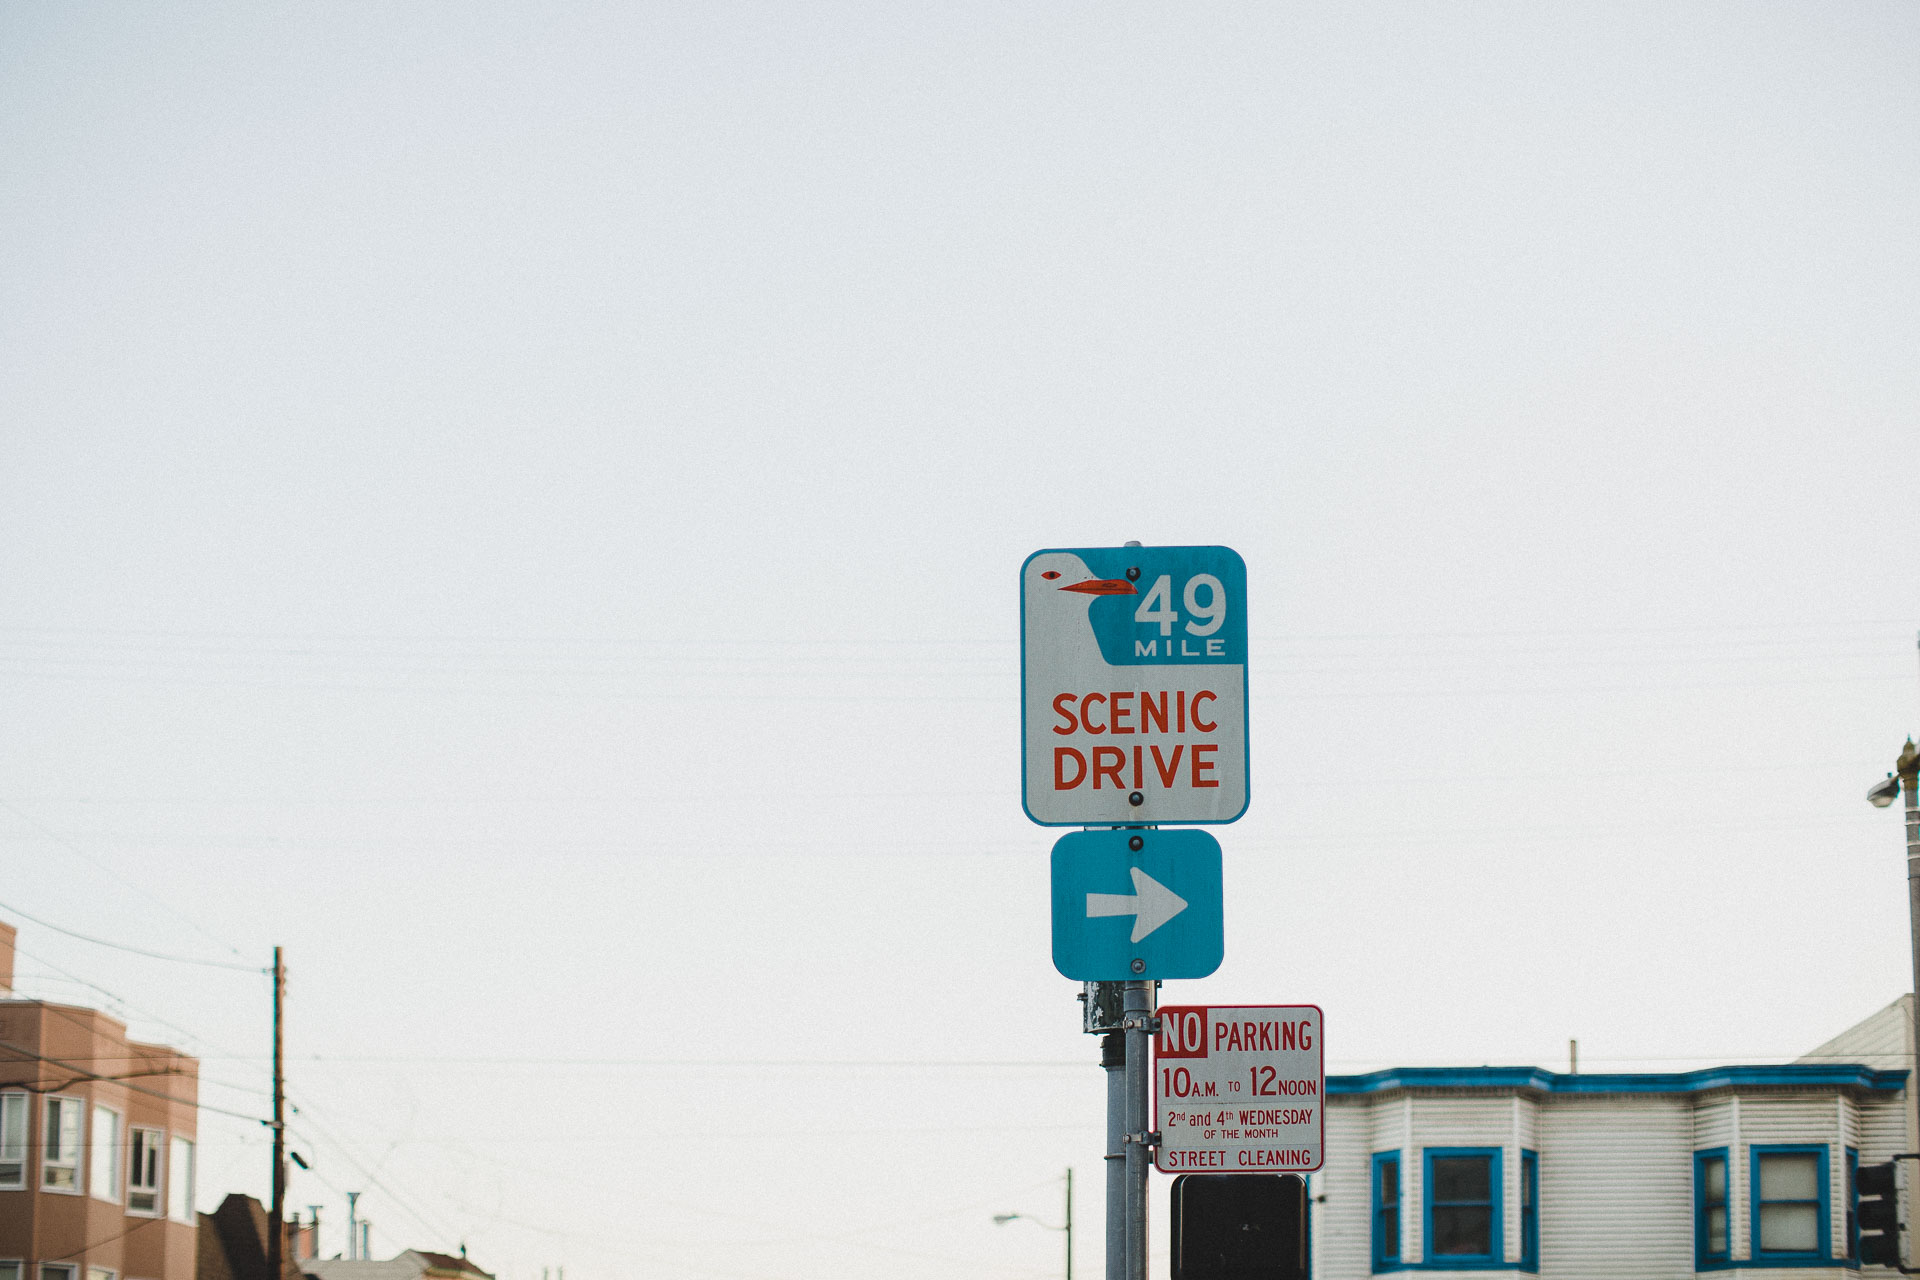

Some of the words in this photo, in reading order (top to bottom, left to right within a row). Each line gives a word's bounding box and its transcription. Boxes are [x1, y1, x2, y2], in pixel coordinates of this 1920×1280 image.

[1134, 573, 1226, 636] 49
[1135, 638, 1225, 656] MILE
[1053, 690, 1217, 735] SCENIC
[1054, 744, 1219, 790] DRIVE
[1162, 1012, 1202, 1052] NO
[1216, 1022, 1312, 1051] PARKING
[1228, 1080, 1241, 1093] TO
[1189, 1111, 1211, 1127] and
[1239, 1109, 1313, 1126] WEDNESDAY
[1203, 1129, 1217, 1140] OF
[1221, 1128, 1240, 1139] THE
[1244, 1128, 1279, 1139] MONTH
[1169, 1150, 1227, 1168] STREET
[1237, 1148, 1311, 1167] CLEANING
